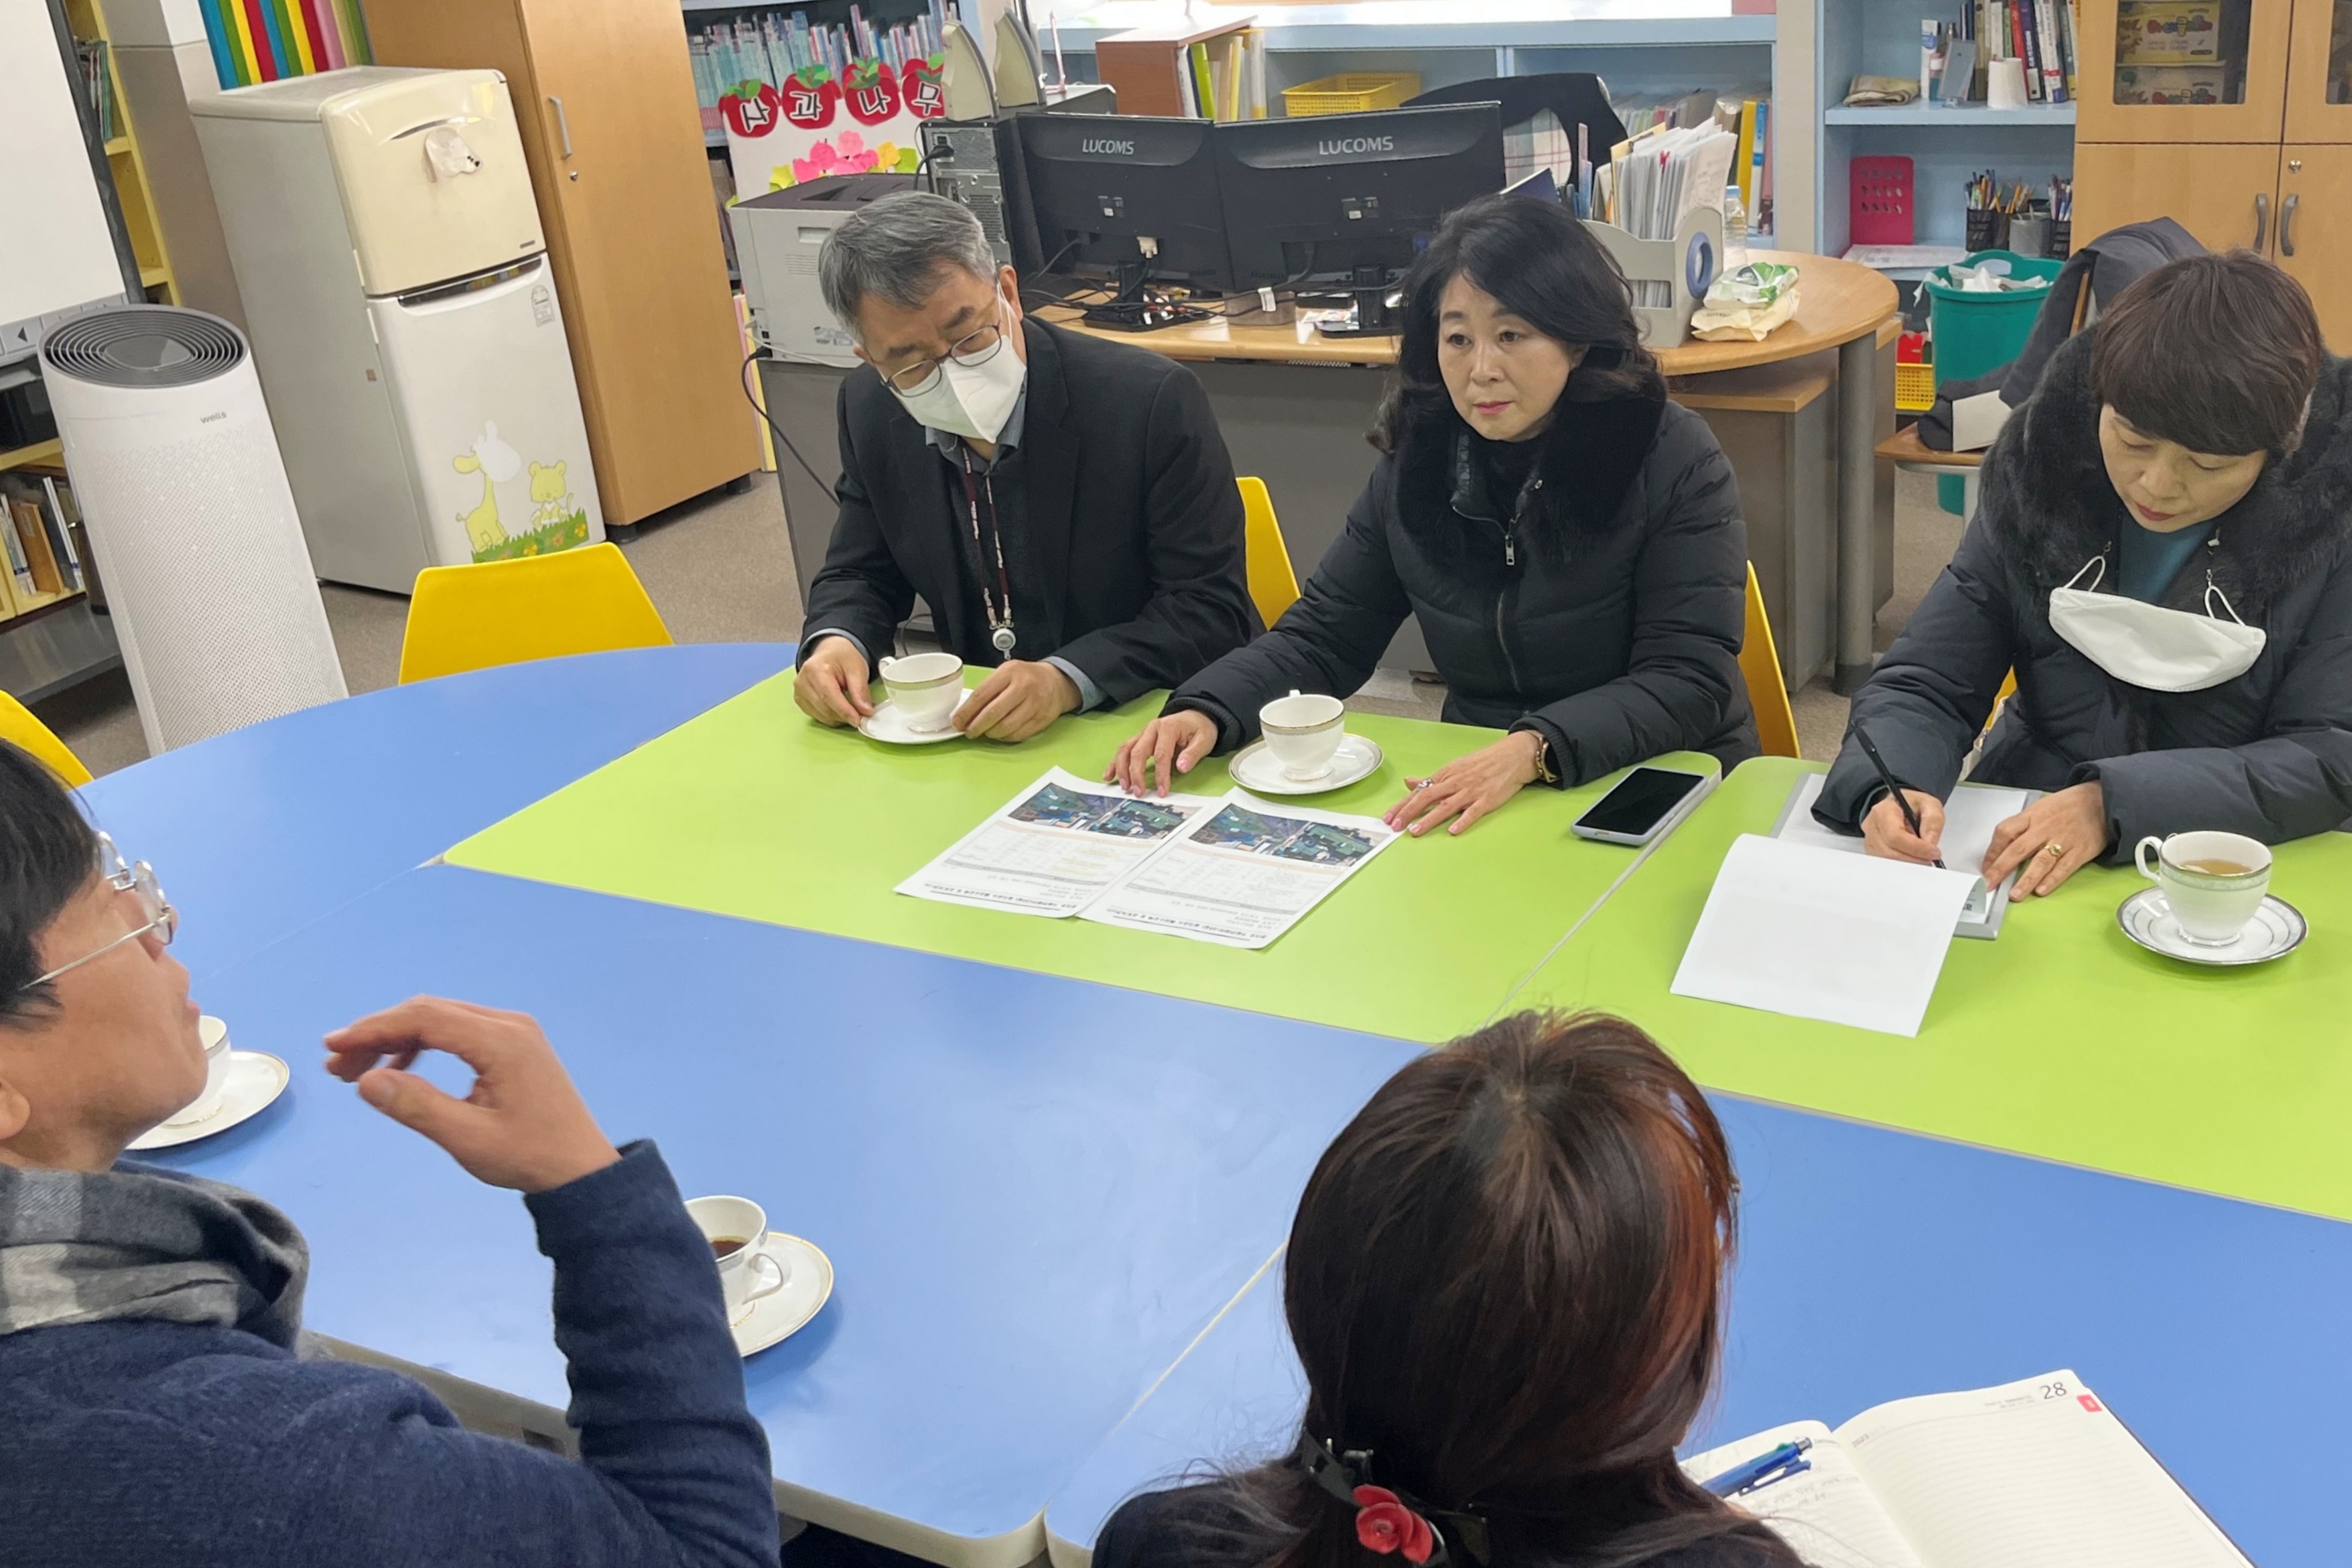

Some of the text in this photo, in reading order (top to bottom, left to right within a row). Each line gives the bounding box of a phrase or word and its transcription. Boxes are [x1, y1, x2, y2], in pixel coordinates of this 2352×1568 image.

[1082, 139, 1134, 155] LUCOMS
[1319, 135, 1394, 155] LUCOMS
[200, 411, 227, 423] wells
[2039, 1382, 2067, 1400] 28
